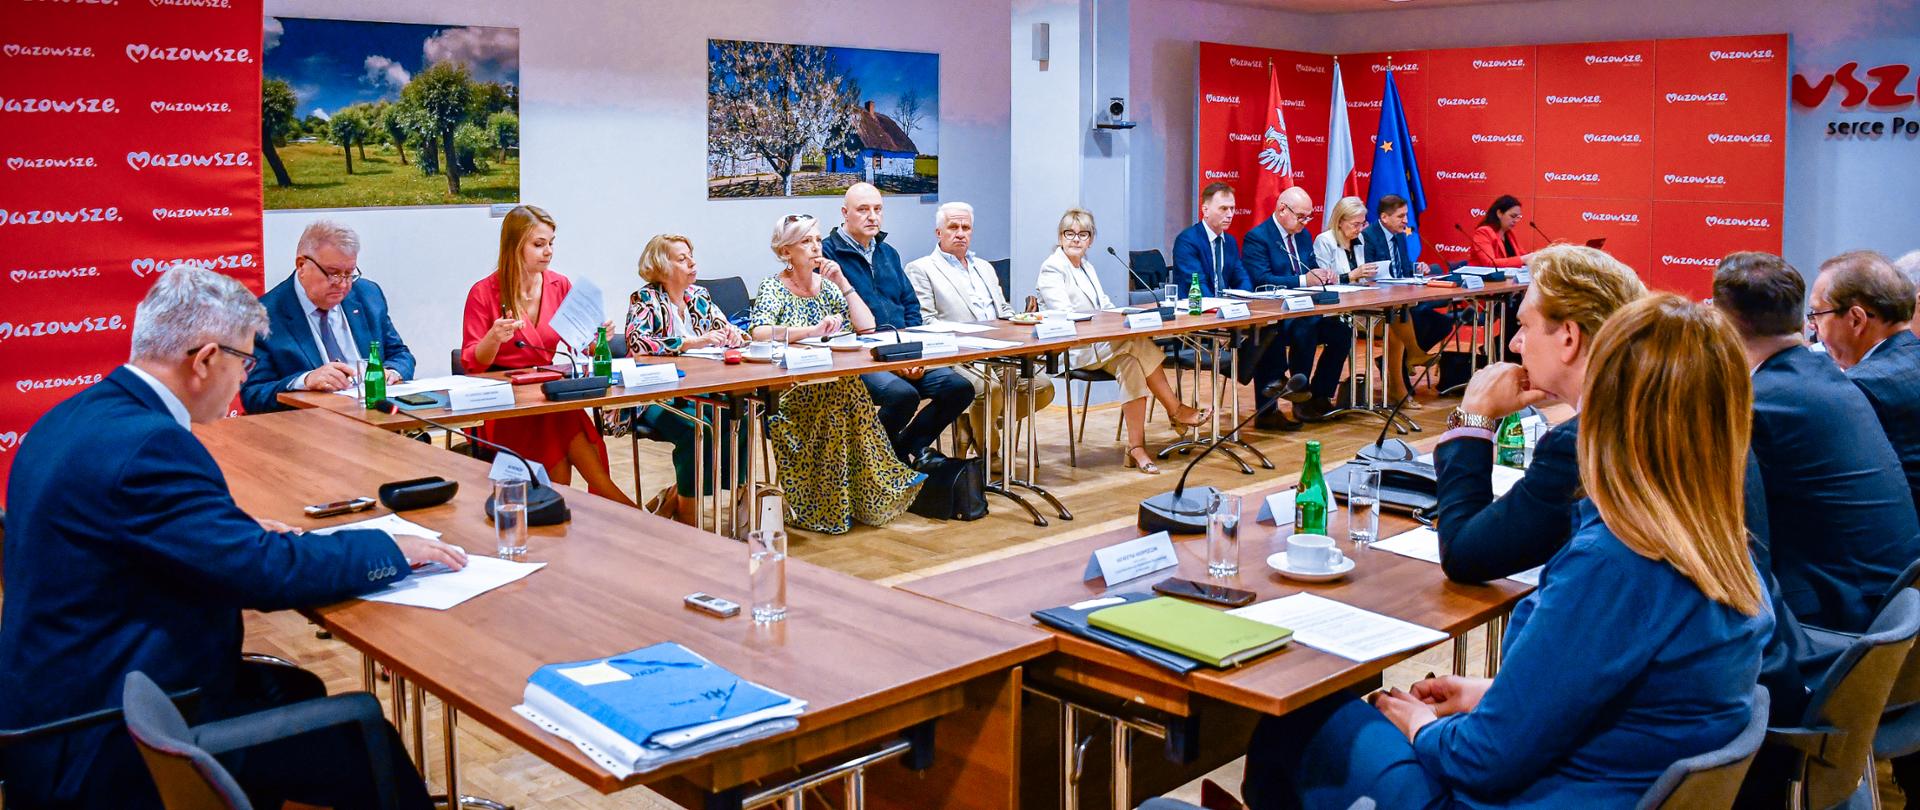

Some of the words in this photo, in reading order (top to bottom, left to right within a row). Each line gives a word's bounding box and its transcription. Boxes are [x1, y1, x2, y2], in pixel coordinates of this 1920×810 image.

[126, 43, 254, 64] Mazowsze.
[0, 97, 120, 114] azowsze.
[1827, 121, 1885, 135] serce
[127, 151, 253, 171] Mazowsze.
